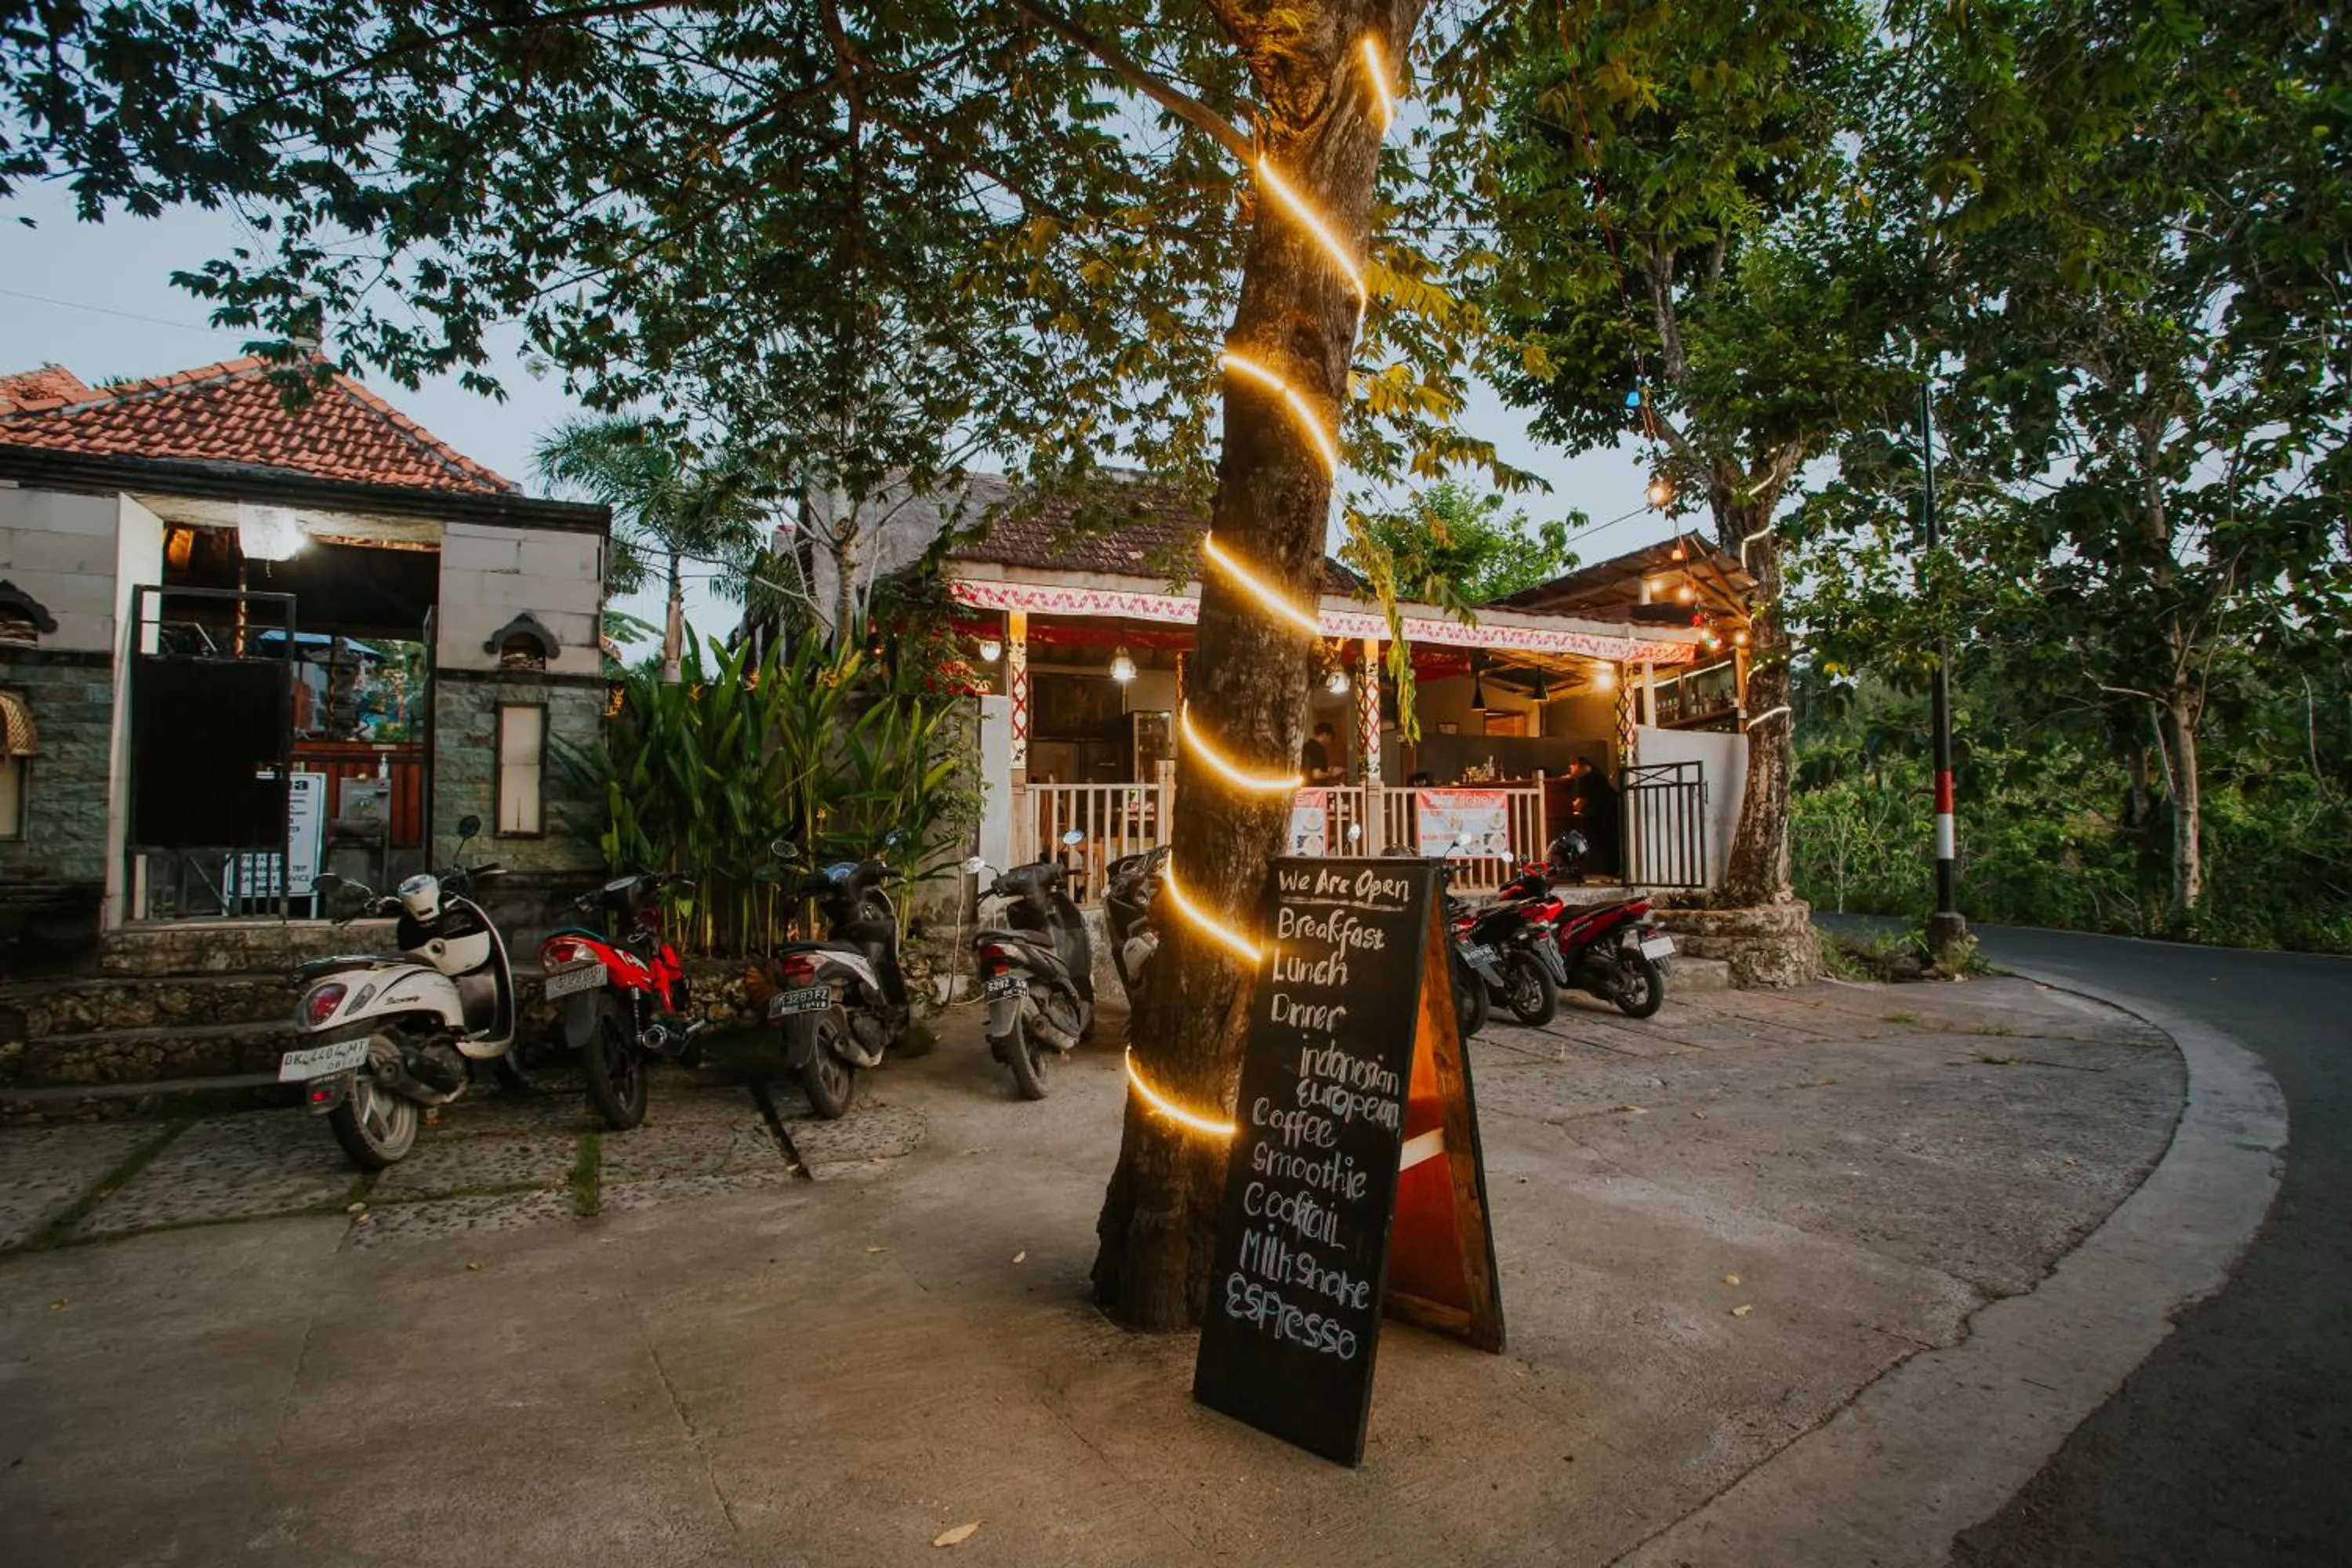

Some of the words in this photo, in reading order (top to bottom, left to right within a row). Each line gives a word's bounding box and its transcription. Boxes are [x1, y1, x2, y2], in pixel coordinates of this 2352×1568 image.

[1279, 869, 1310, 891] We
[1314, 868, 1350, 895] Are
[1356, 869, 1409, 902] Open
[1278, 907, 1385, 961] Breakfast
[1272, 948, 1348, 986] Lunch
[1252, 1097, 1337, 1149] Coffee
